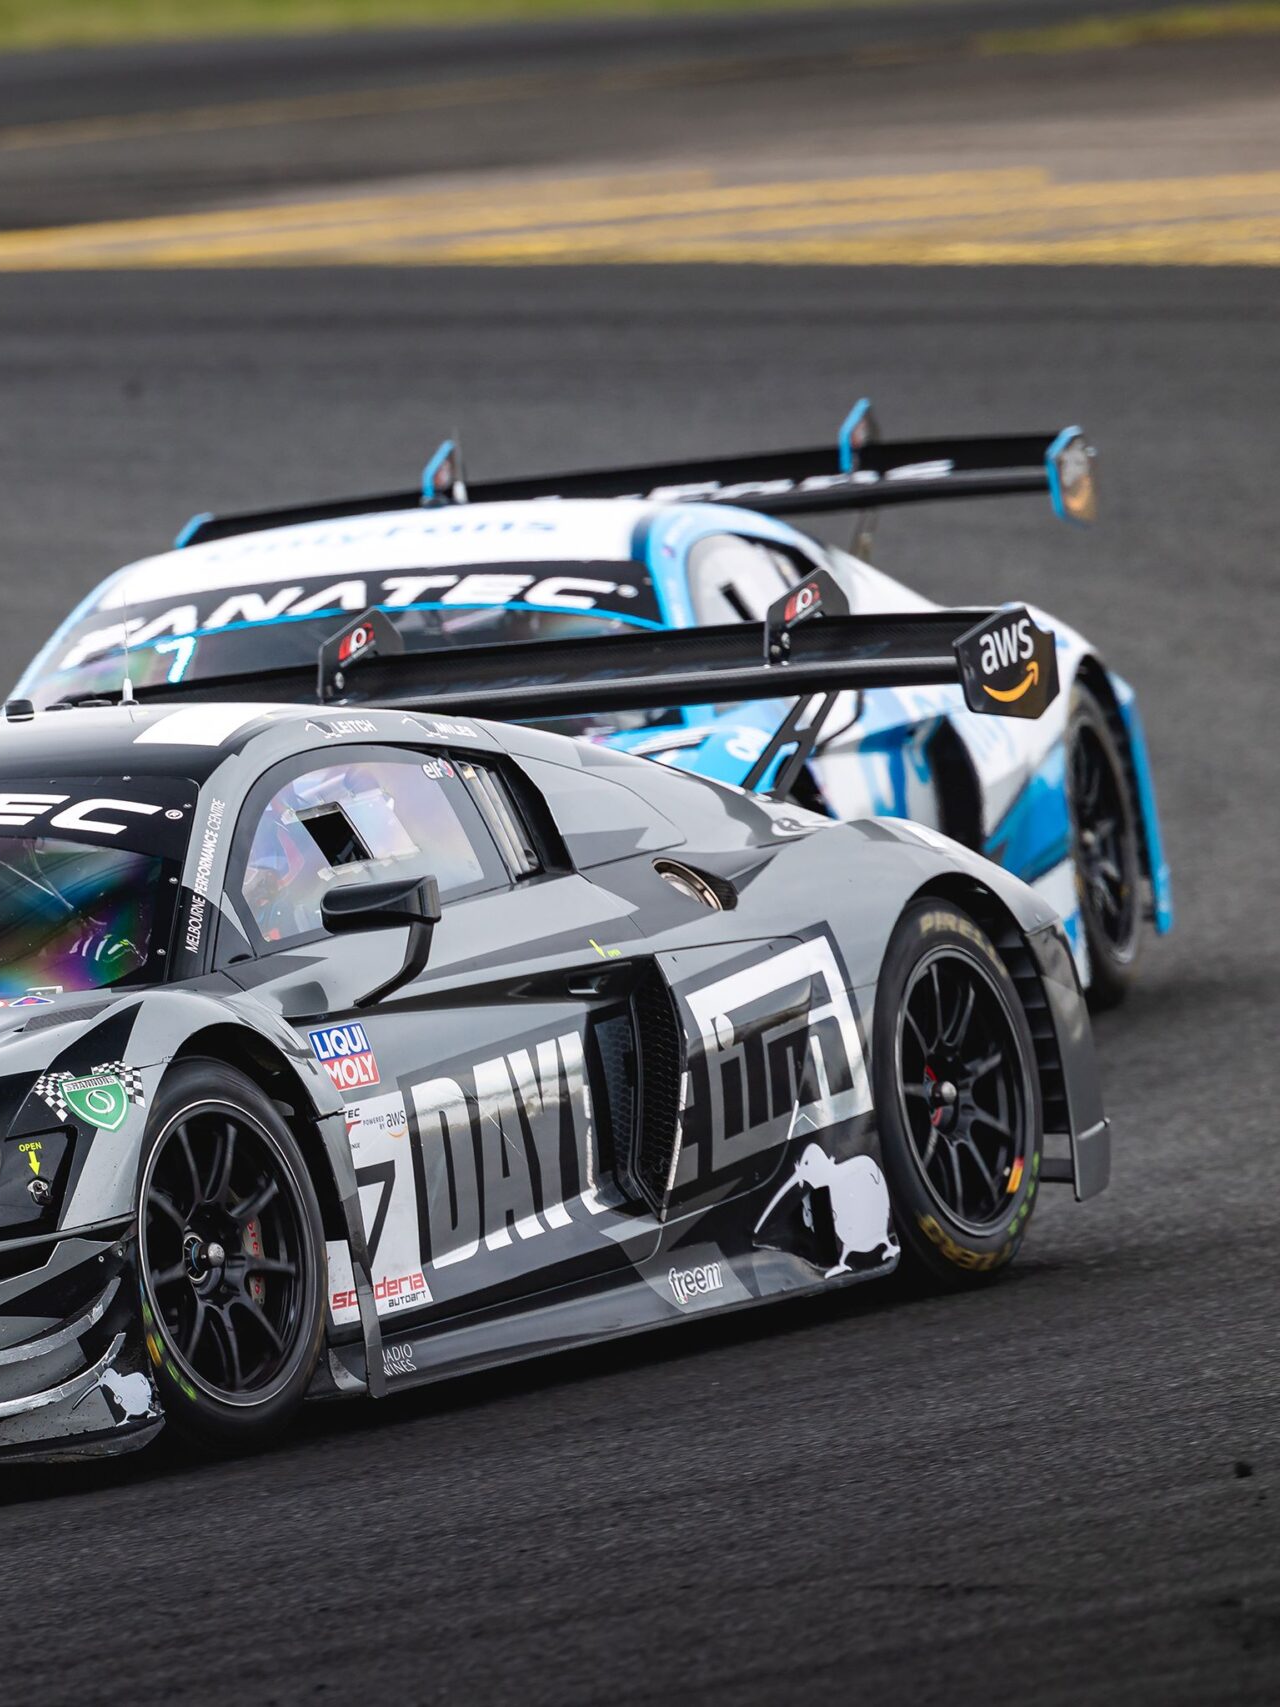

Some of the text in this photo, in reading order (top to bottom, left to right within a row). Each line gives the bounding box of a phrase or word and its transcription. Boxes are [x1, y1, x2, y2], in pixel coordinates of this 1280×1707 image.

[59, 573, 617, 671] FANATEC
[979, 617, 1034, 675] aws
[331, 719, 378, 734] LEITCH
[422, 760, 444, 780] elf
[185, 798, 226, 953] MELBOURNE PERFORMANCE CENTRE
[312, 1025, 369, 1060] LIQUI
[65, 1074, 116, 1091] SHANNONS
[323, 1054, 376, 1087] MOLY
[386, 1110, 406, 1128] aws
[18, 1141, 42, 1152] OPEN
[355, 1159, 396, 1269] 7
[332, 1272, 426, 1310] scderia
[667, 1261, 723, 1304] freem
